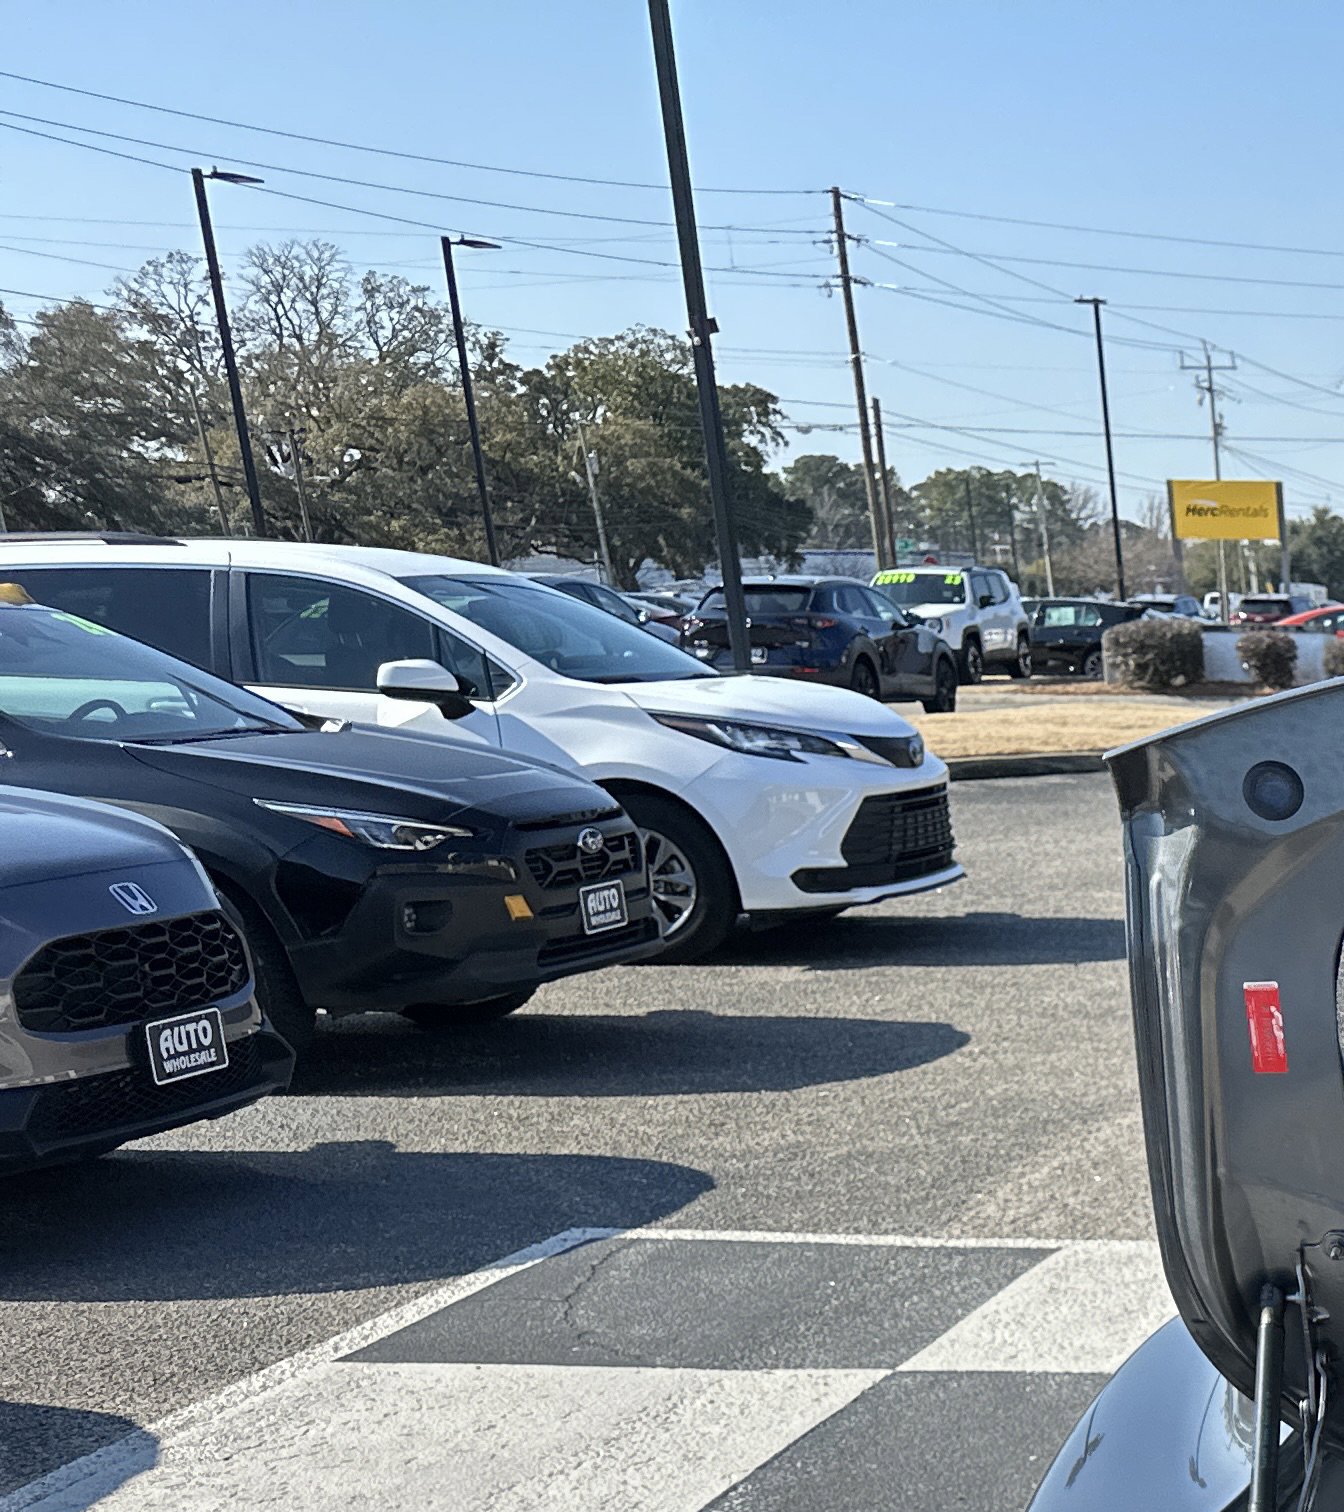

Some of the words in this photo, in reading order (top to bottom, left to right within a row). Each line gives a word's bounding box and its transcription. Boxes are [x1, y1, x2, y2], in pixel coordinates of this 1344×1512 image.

[588, 888, 618, 915] AUTO
[160, 1020, 212, 1059] AUTO
[163, 1048, 217, 1073] WHOLESALE
